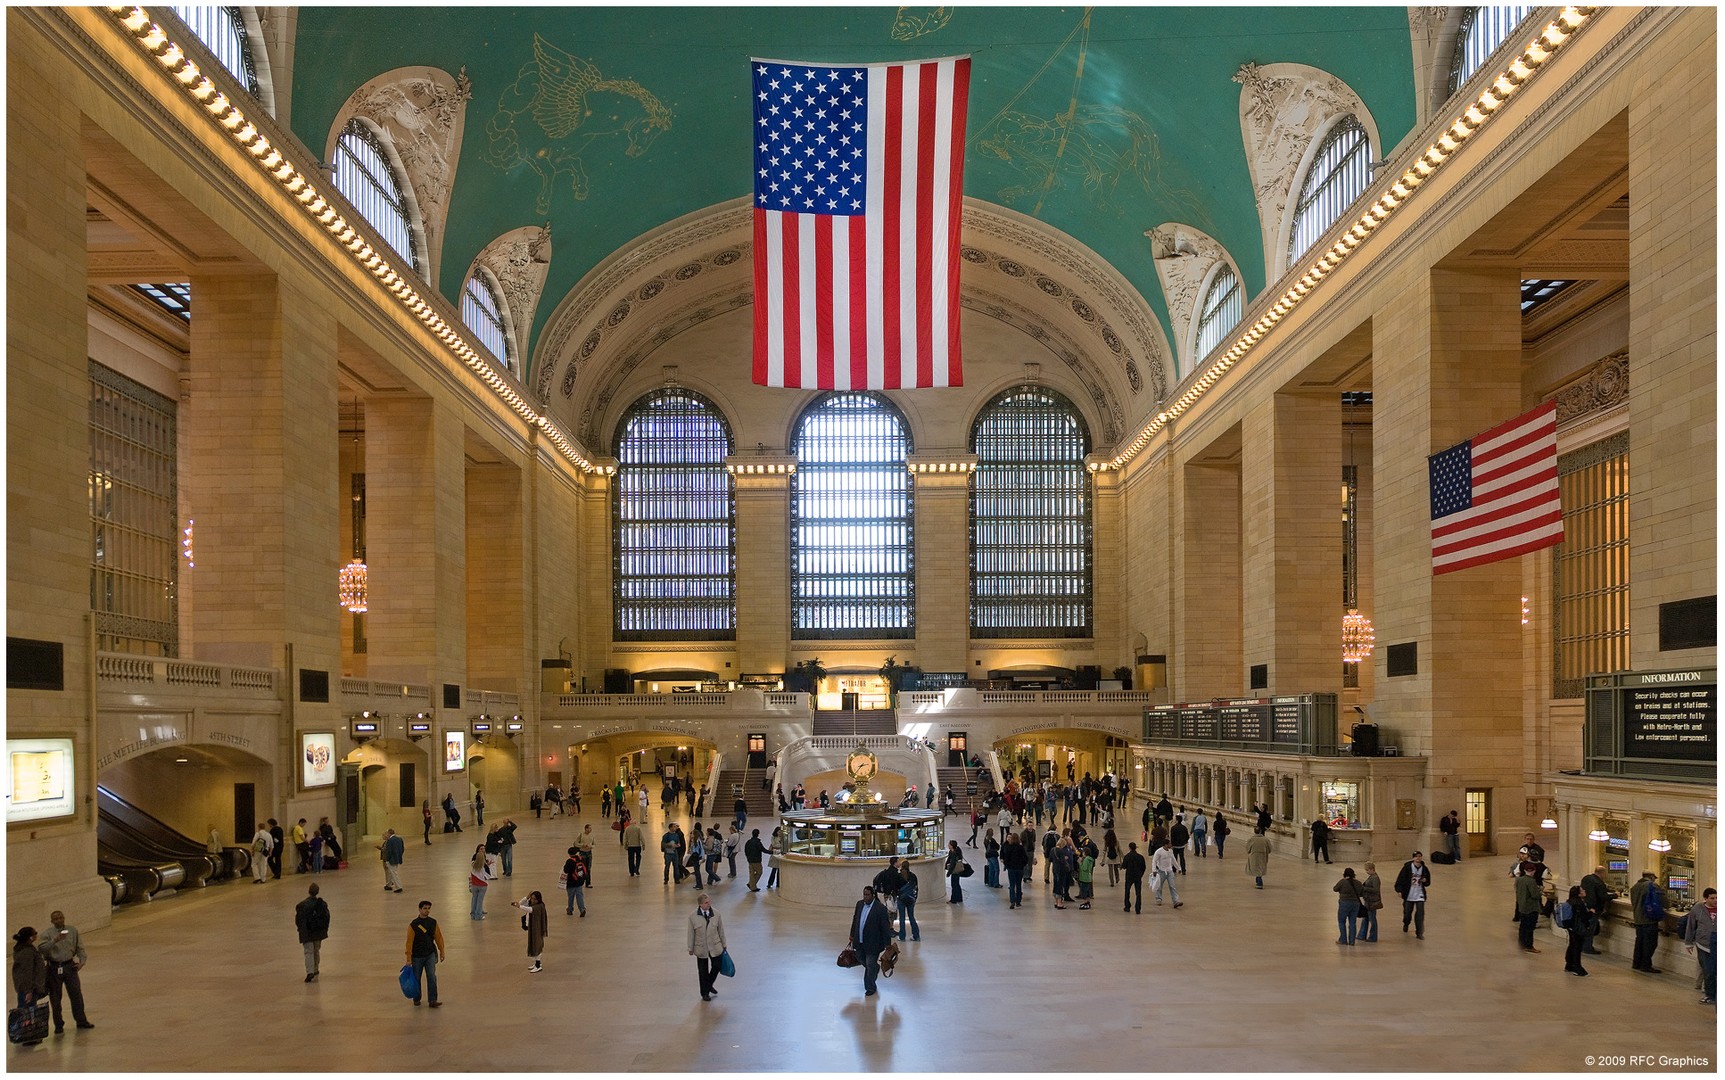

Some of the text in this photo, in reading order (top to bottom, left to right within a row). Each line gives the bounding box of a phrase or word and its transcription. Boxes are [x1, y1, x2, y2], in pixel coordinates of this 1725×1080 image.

[1641, 671, 1701, 684] INFORMATION
[1660, 713, 1687, 721] cooperate
[1690, 712, 1705, 720] fully
[652, 725, 686, 734] LEXINGTON
[1012, 724, 1046, 735] LEXINGTON
[227, 734, 250, 748] STREET
[96, 754, 113, 771] THE
[113, 739, 150, 761] METLIFE
